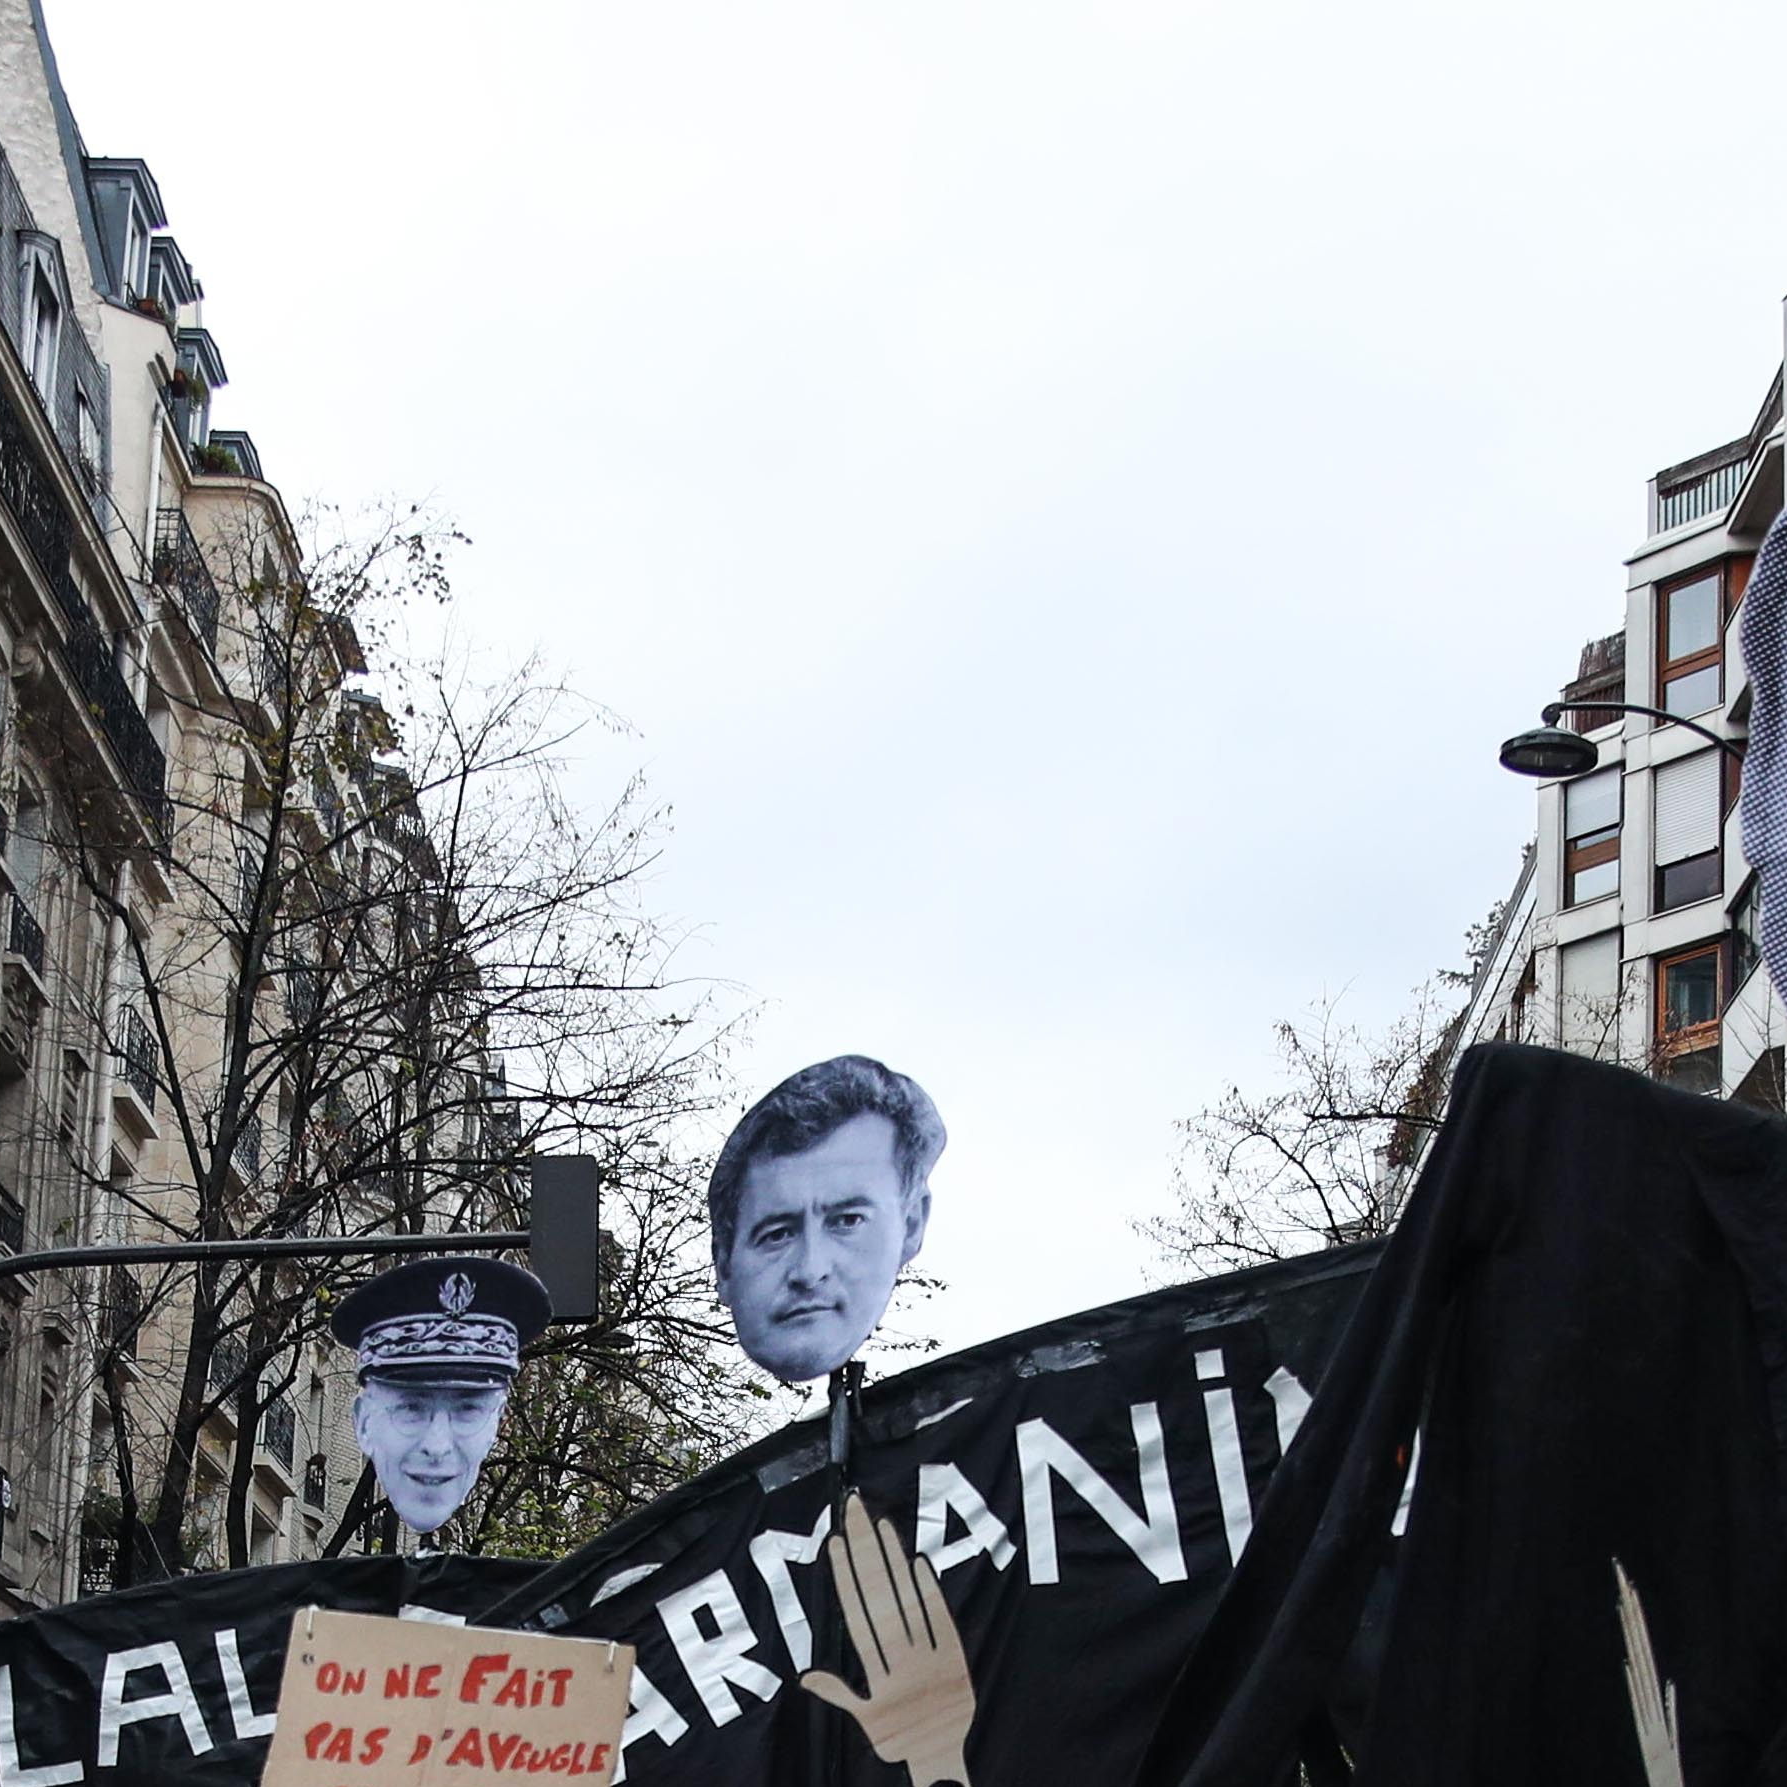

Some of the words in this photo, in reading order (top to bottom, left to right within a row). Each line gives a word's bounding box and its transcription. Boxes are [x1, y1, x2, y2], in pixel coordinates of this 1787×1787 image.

[383, 1663, 443, 1699] NE
[304, 1721, 391, 1766] PAS
[407, 1727, 612, 1777] D'AVEUGLE
